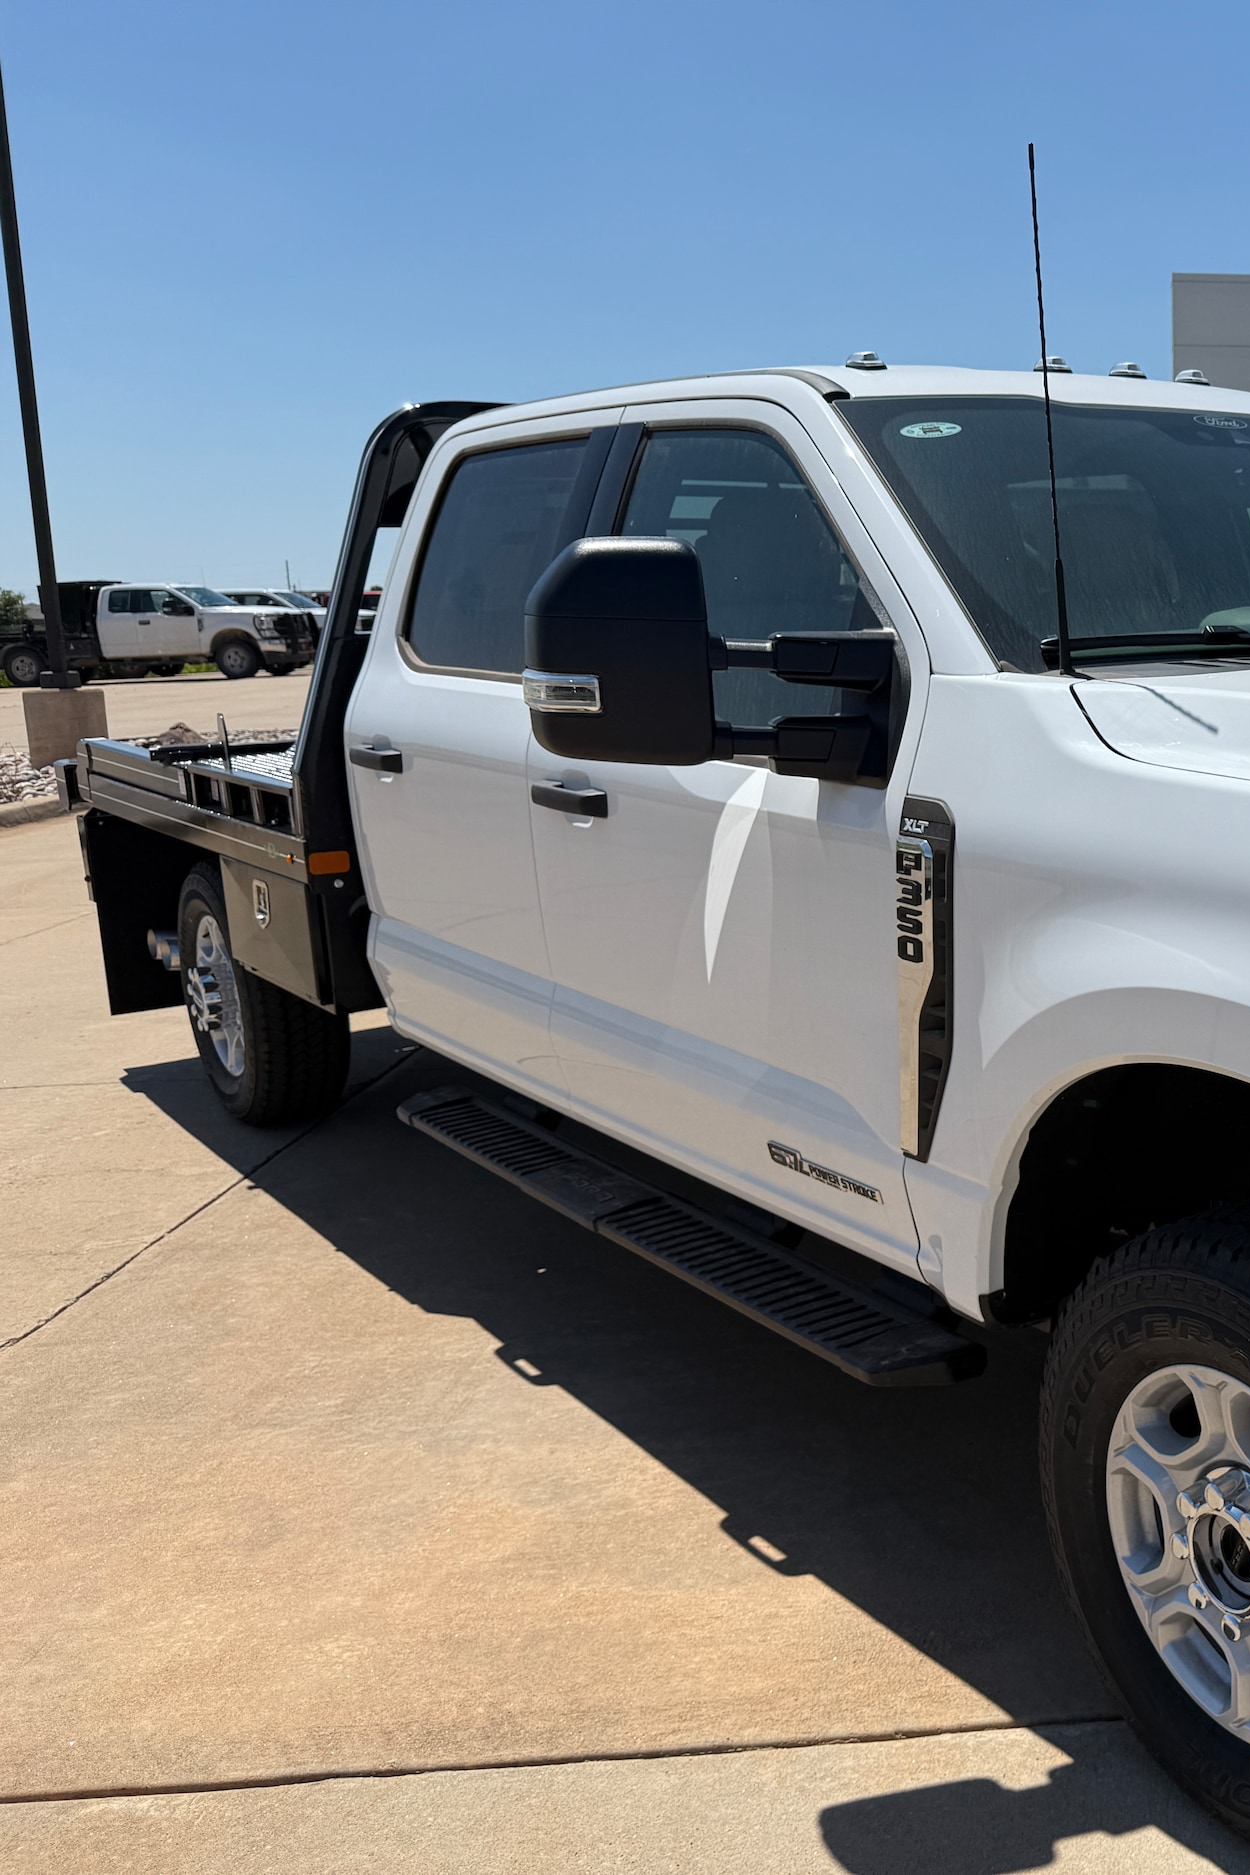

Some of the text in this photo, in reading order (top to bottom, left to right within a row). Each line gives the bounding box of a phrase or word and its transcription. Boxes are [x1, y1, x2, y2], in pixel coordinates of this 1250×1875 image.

[903, 818, 929, 834] XLT
[808, 1164, 841, 1187] POWER
[840, 1178, 879, 1202] STROKE
[1063, 1312, 1215, 1450] DUELER
